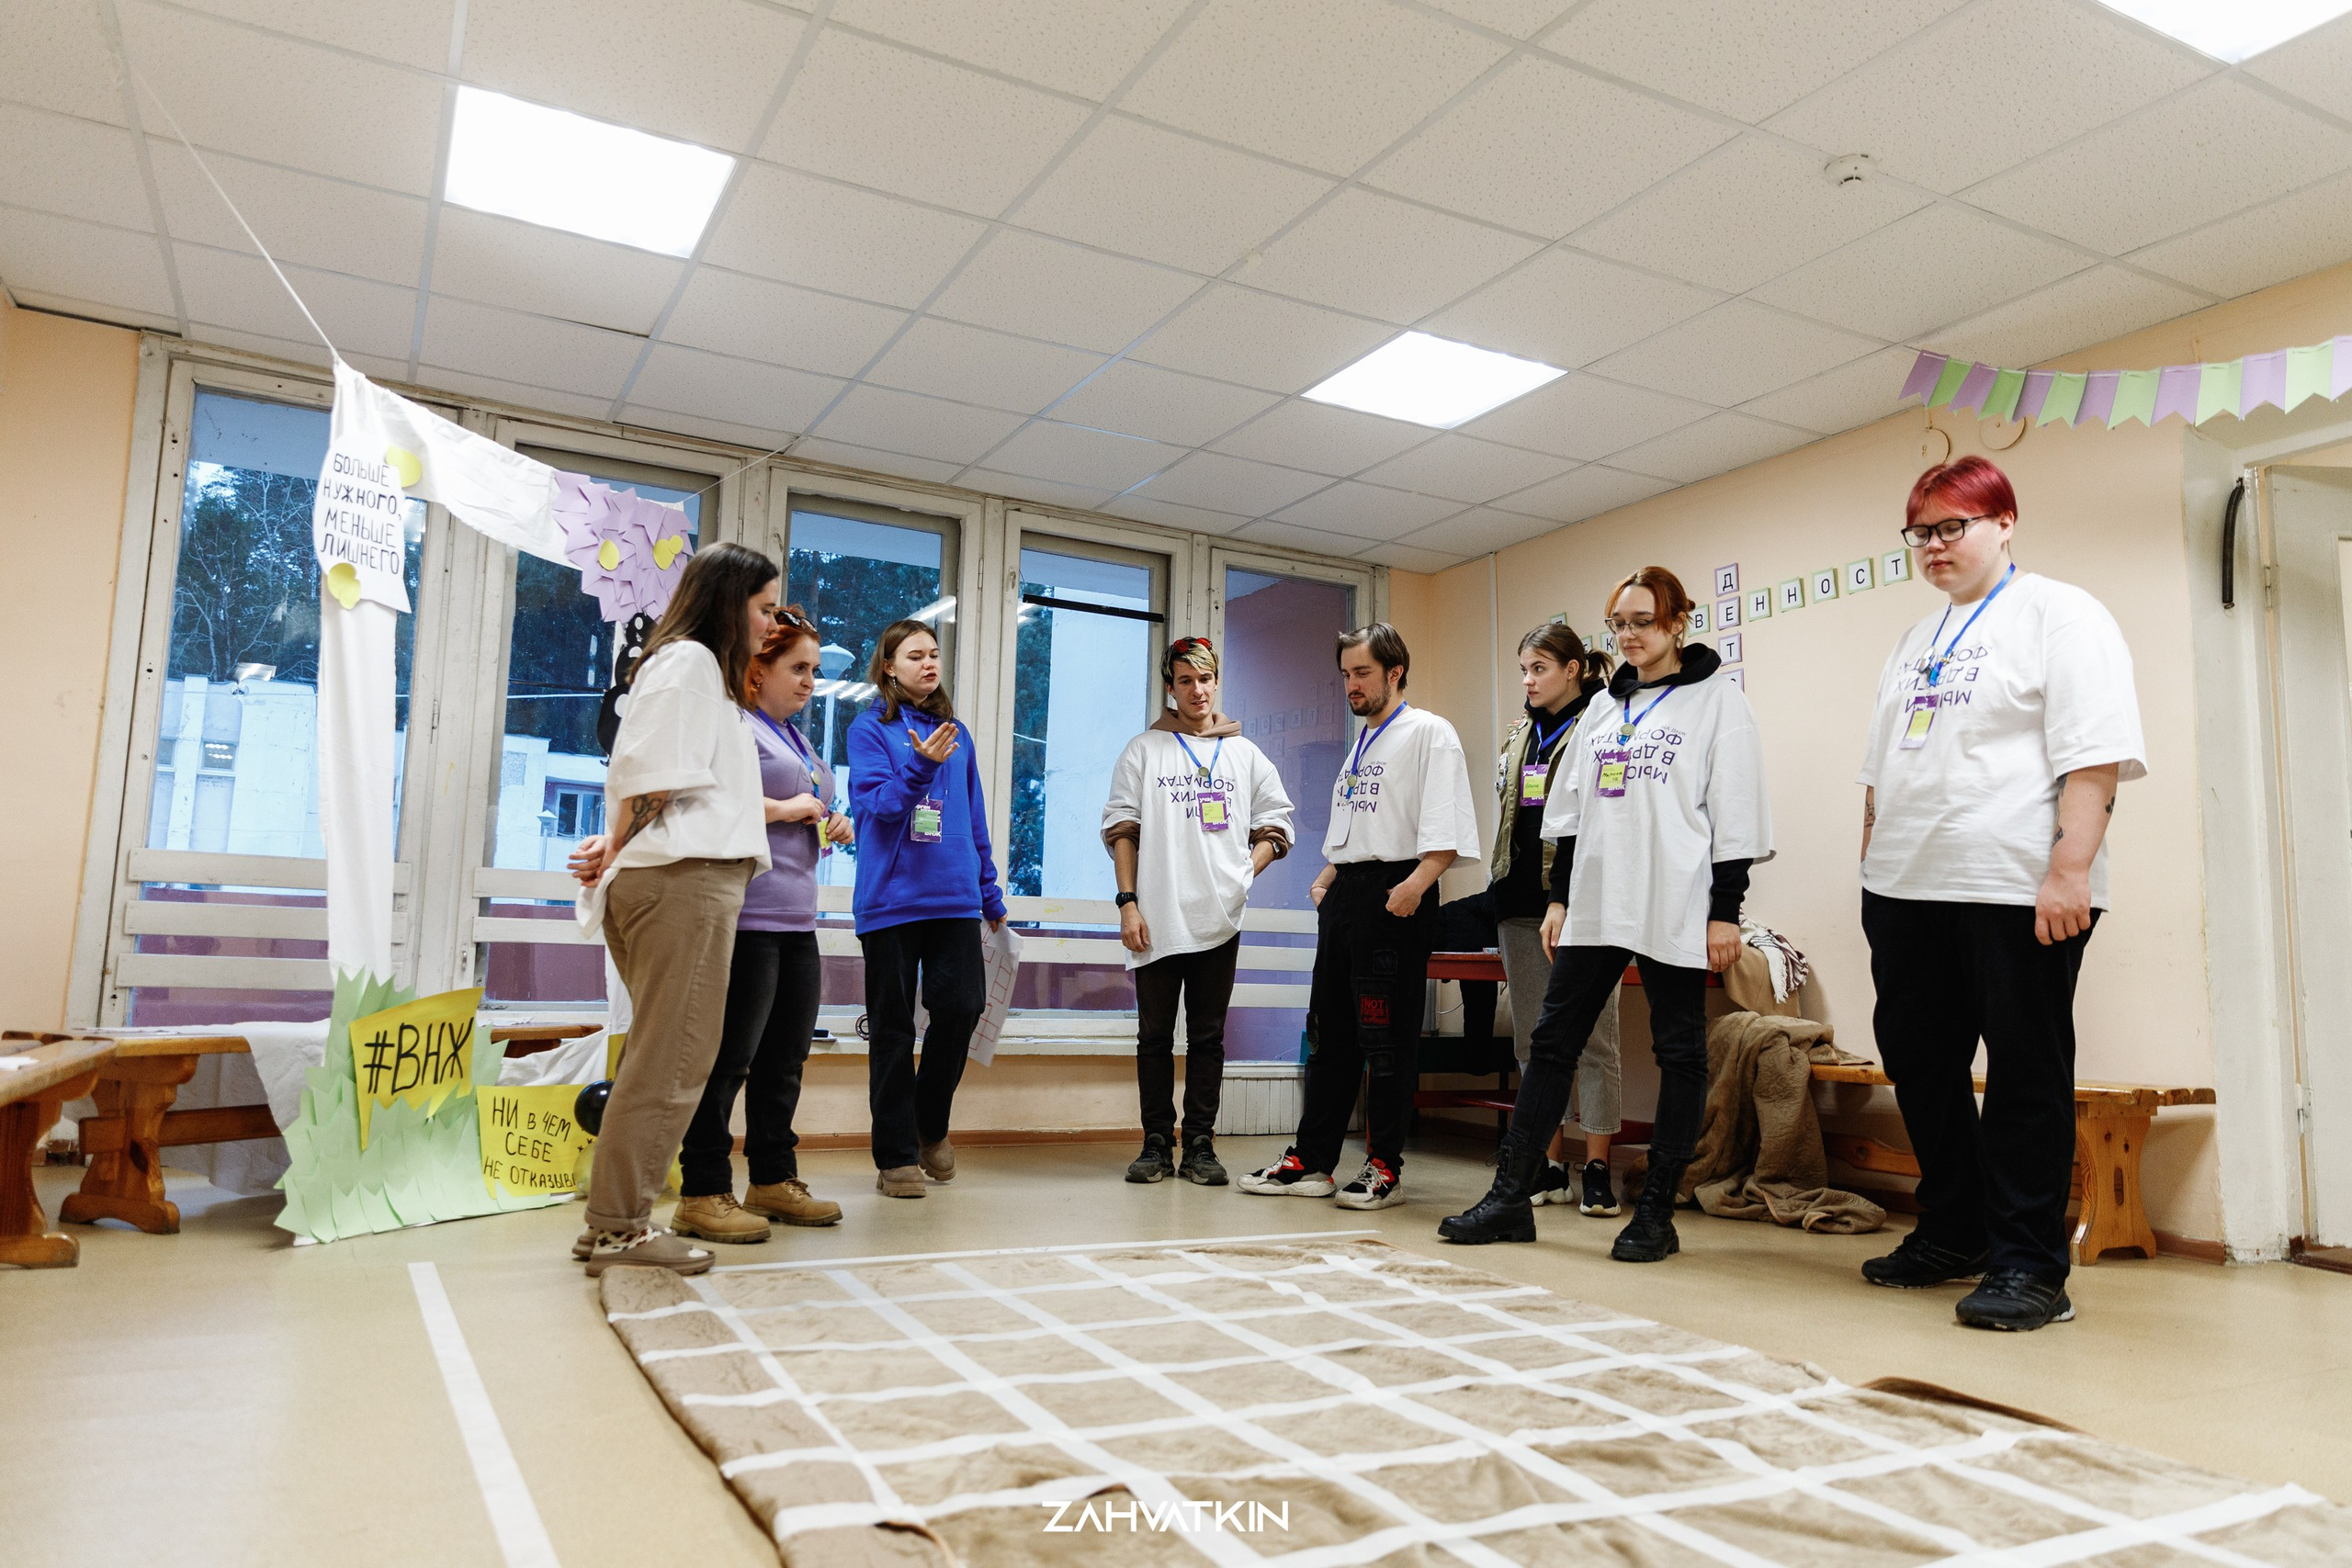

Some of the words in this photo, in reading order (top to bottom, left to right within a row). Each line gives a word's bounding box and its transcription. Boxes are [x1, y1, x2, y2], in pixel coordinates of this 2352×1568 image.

[334, 453, 390, 488] БОЛЬШЕ
[323, 478, 401, 521] НУЖНОГО,
[324, 507, 396, 548] МЕНЬШЕ
[321, 533, 400, 575] ЛИШНЕГО
[1723, 572, 1736, 682] ДЕТ
[1905, 691, 1972, 714] МЫИ
[1364, 999, 1385, 1009] NOT
[363, 1016, 474, 1095] #ВНЖ
[492, 1096, 518, 1129] НИ
[542, 1111, 571, 1142] ЧЕМ
[483, 1156, 503, 1179] НЕ
[505, 1132, 553, 1163] СЕБЕ
